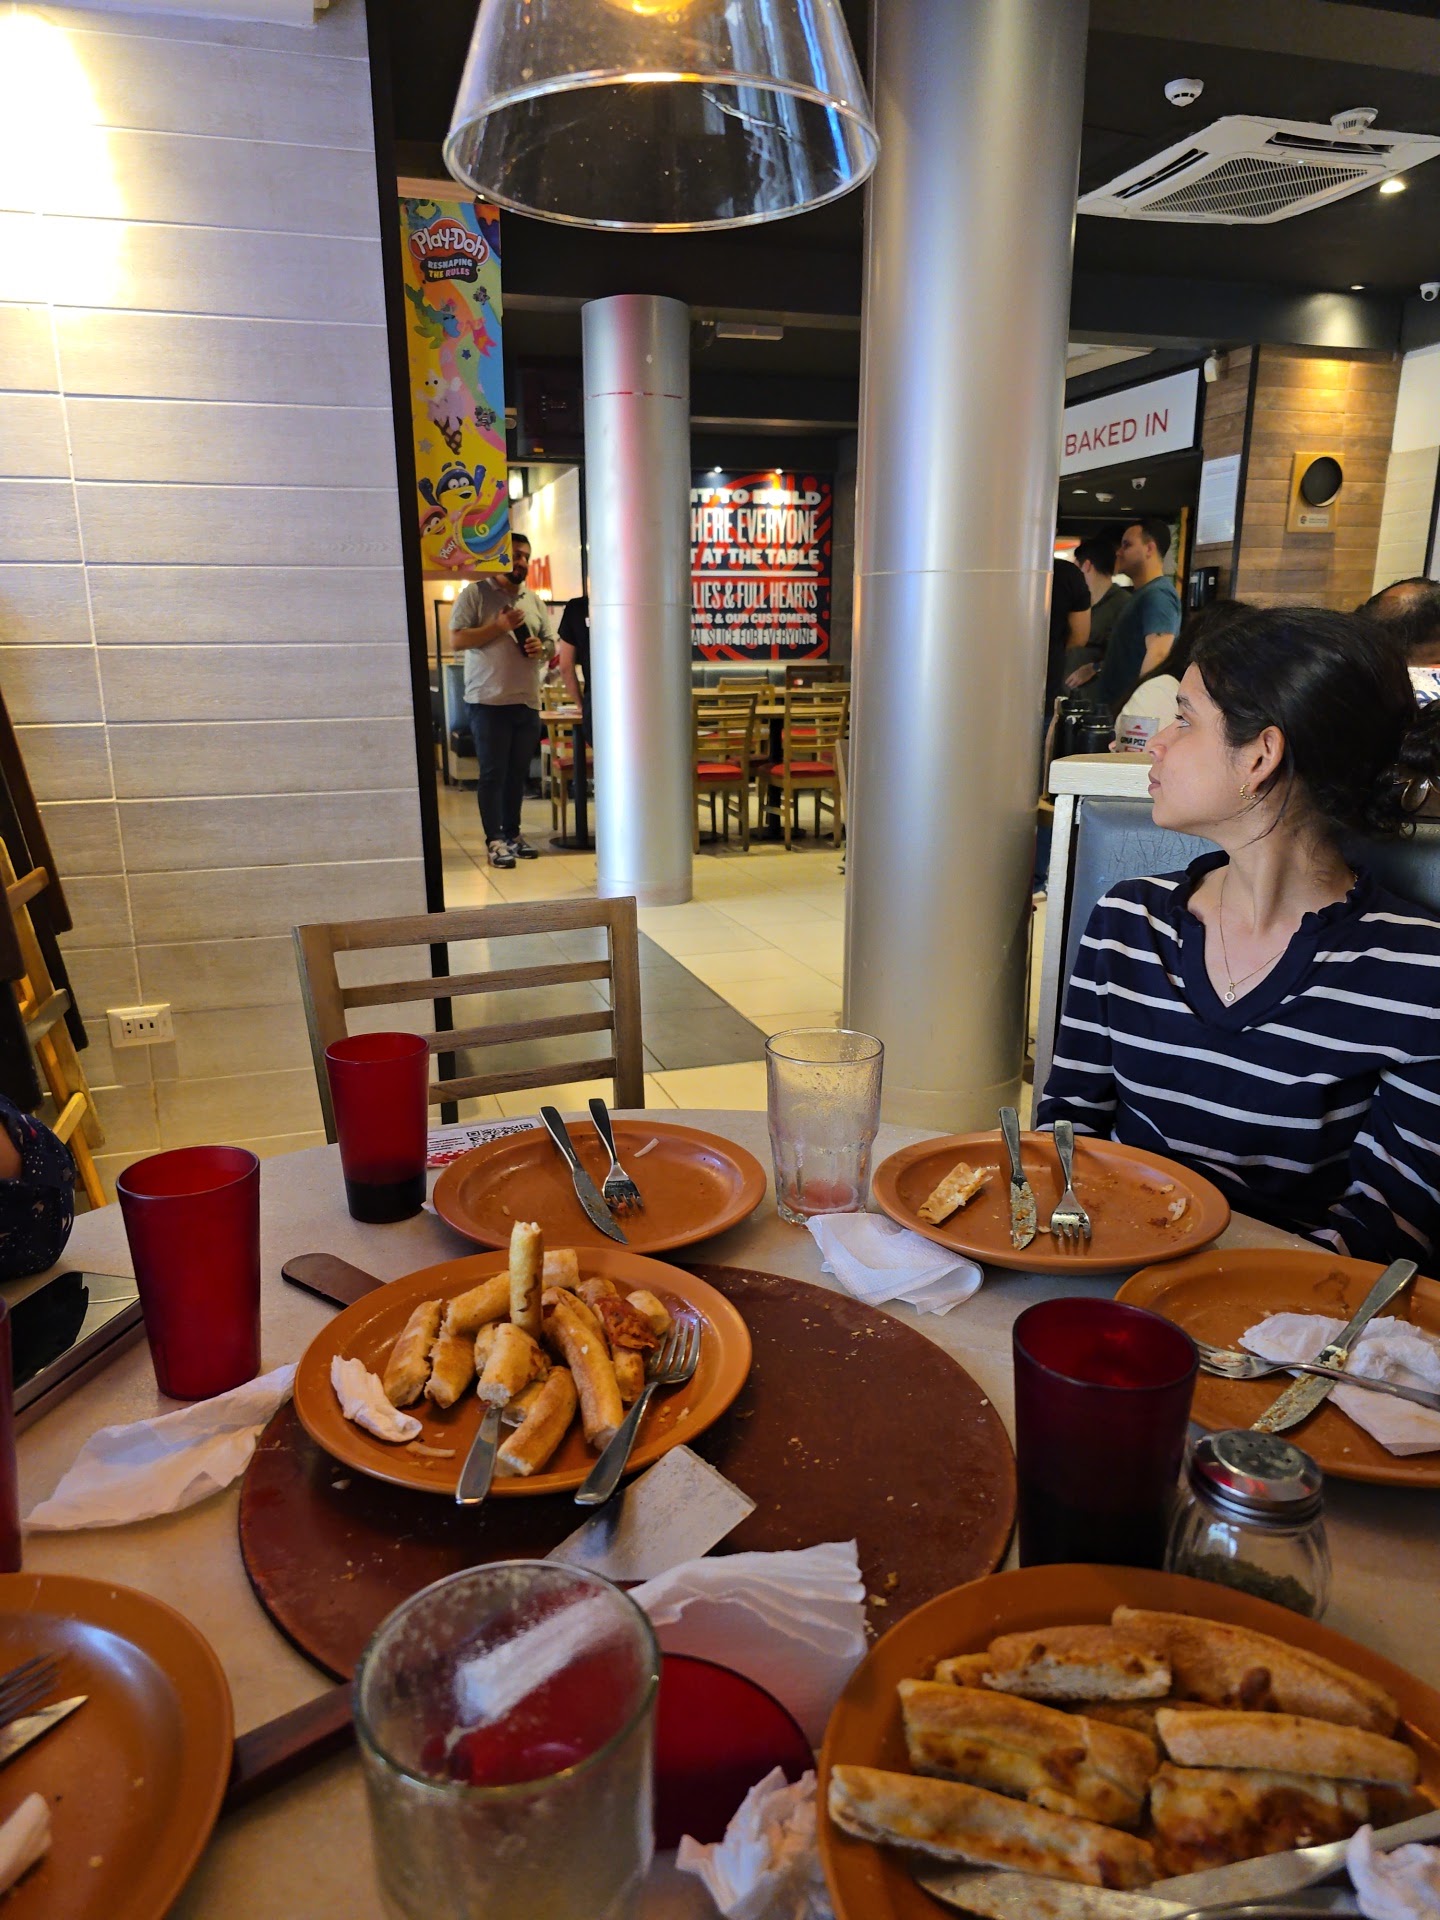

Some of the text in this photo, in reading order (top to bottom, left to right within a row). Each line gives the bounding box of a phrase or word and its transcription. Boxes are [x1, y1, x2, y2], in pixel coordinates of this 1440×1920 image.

[411, 228, 485, 259] Play-Doh
[428, 258, 473, 269] RESHAPING
[429, 268, 470, 278] THE RULES
[1065, 408, 1169, 456] BAKED IN
[715, 488, 749, 504] TO
[753, 489, 821, 504] BLD
[691, 507, 819, 544] HERE EVERYONE
[701, 548, 725, 565] AT
[726, 548, 763, 565] THE
[765, 549, 820, 566] TABLE
[723, 581, 736, 609] &
[737, 581, 768, 609] FULL
[769, 581, 818, 609] HEARTS
[714, 613, 724, 624] &
[725, 613, 749, 624] OUR
[750, 613, 818, 624] CUSTOMERS
[759, 628, 817, 646] EVERYONE
